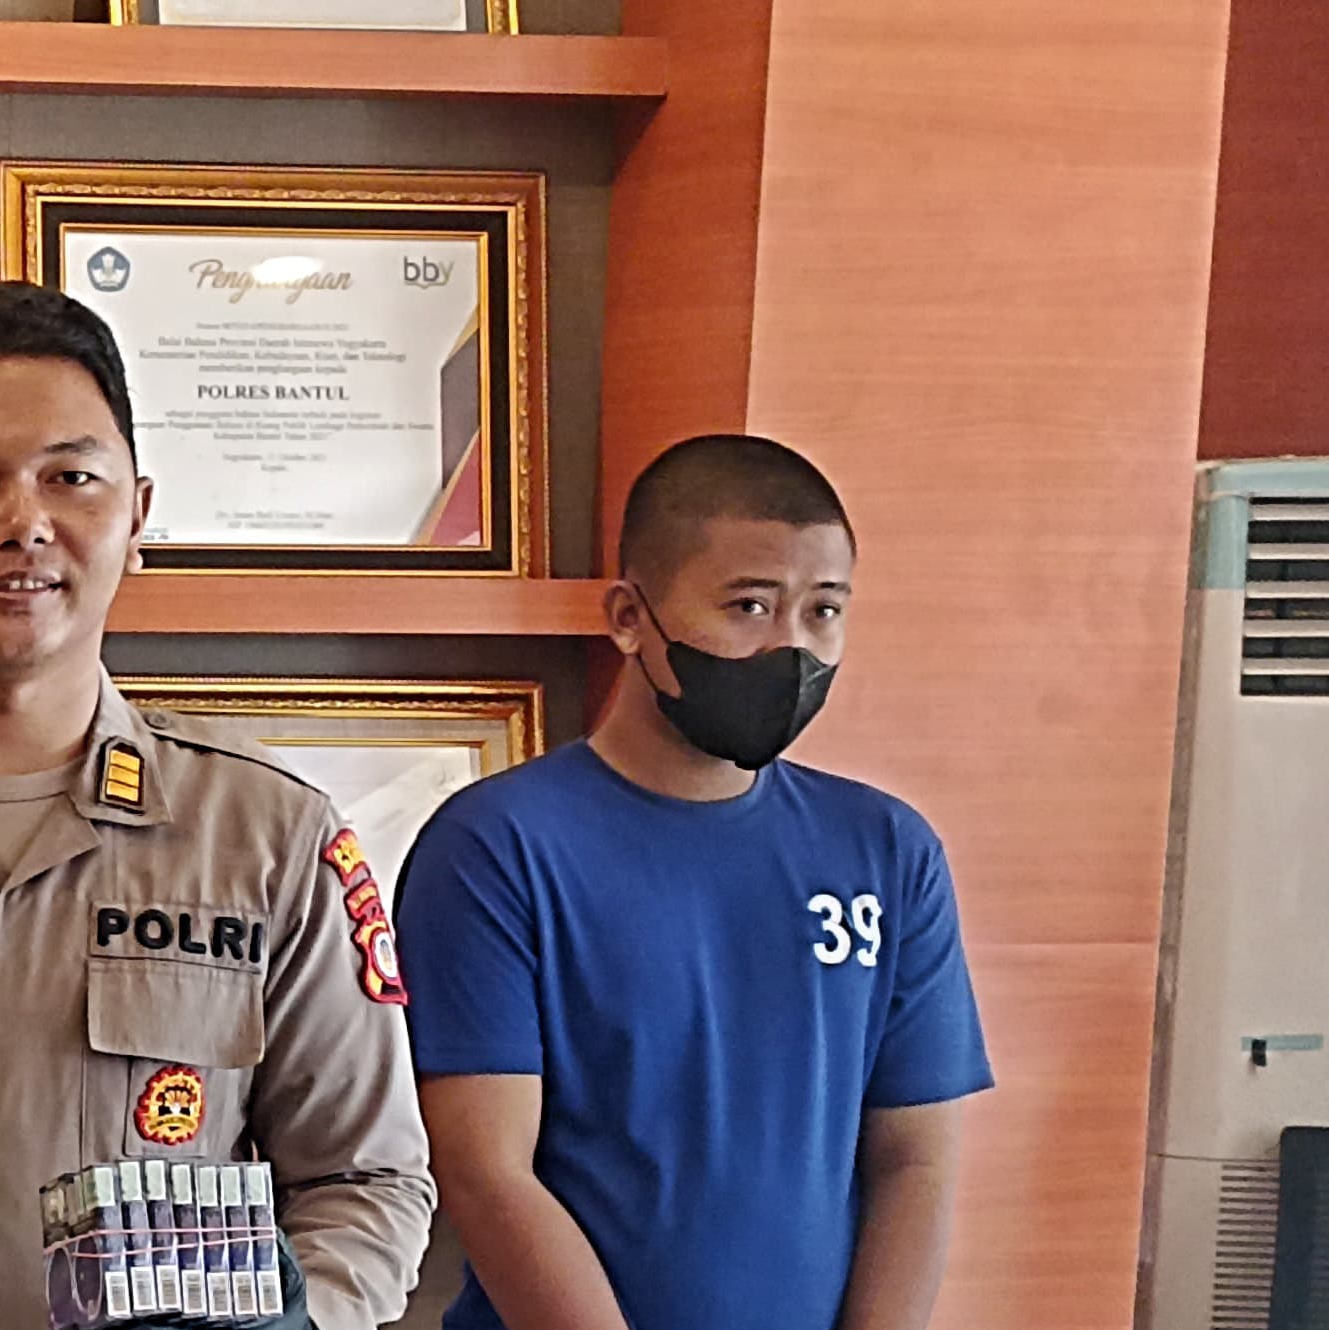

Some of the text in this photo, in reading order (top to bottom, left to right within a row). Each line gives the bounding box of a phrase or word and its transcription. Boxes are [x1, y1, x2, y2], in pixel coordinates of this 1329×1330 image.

[197, 385, 350, 401] POLRES BANTUL
[97, 908, 264, 963] POLRI
[807, 894, 883, 967] 39
